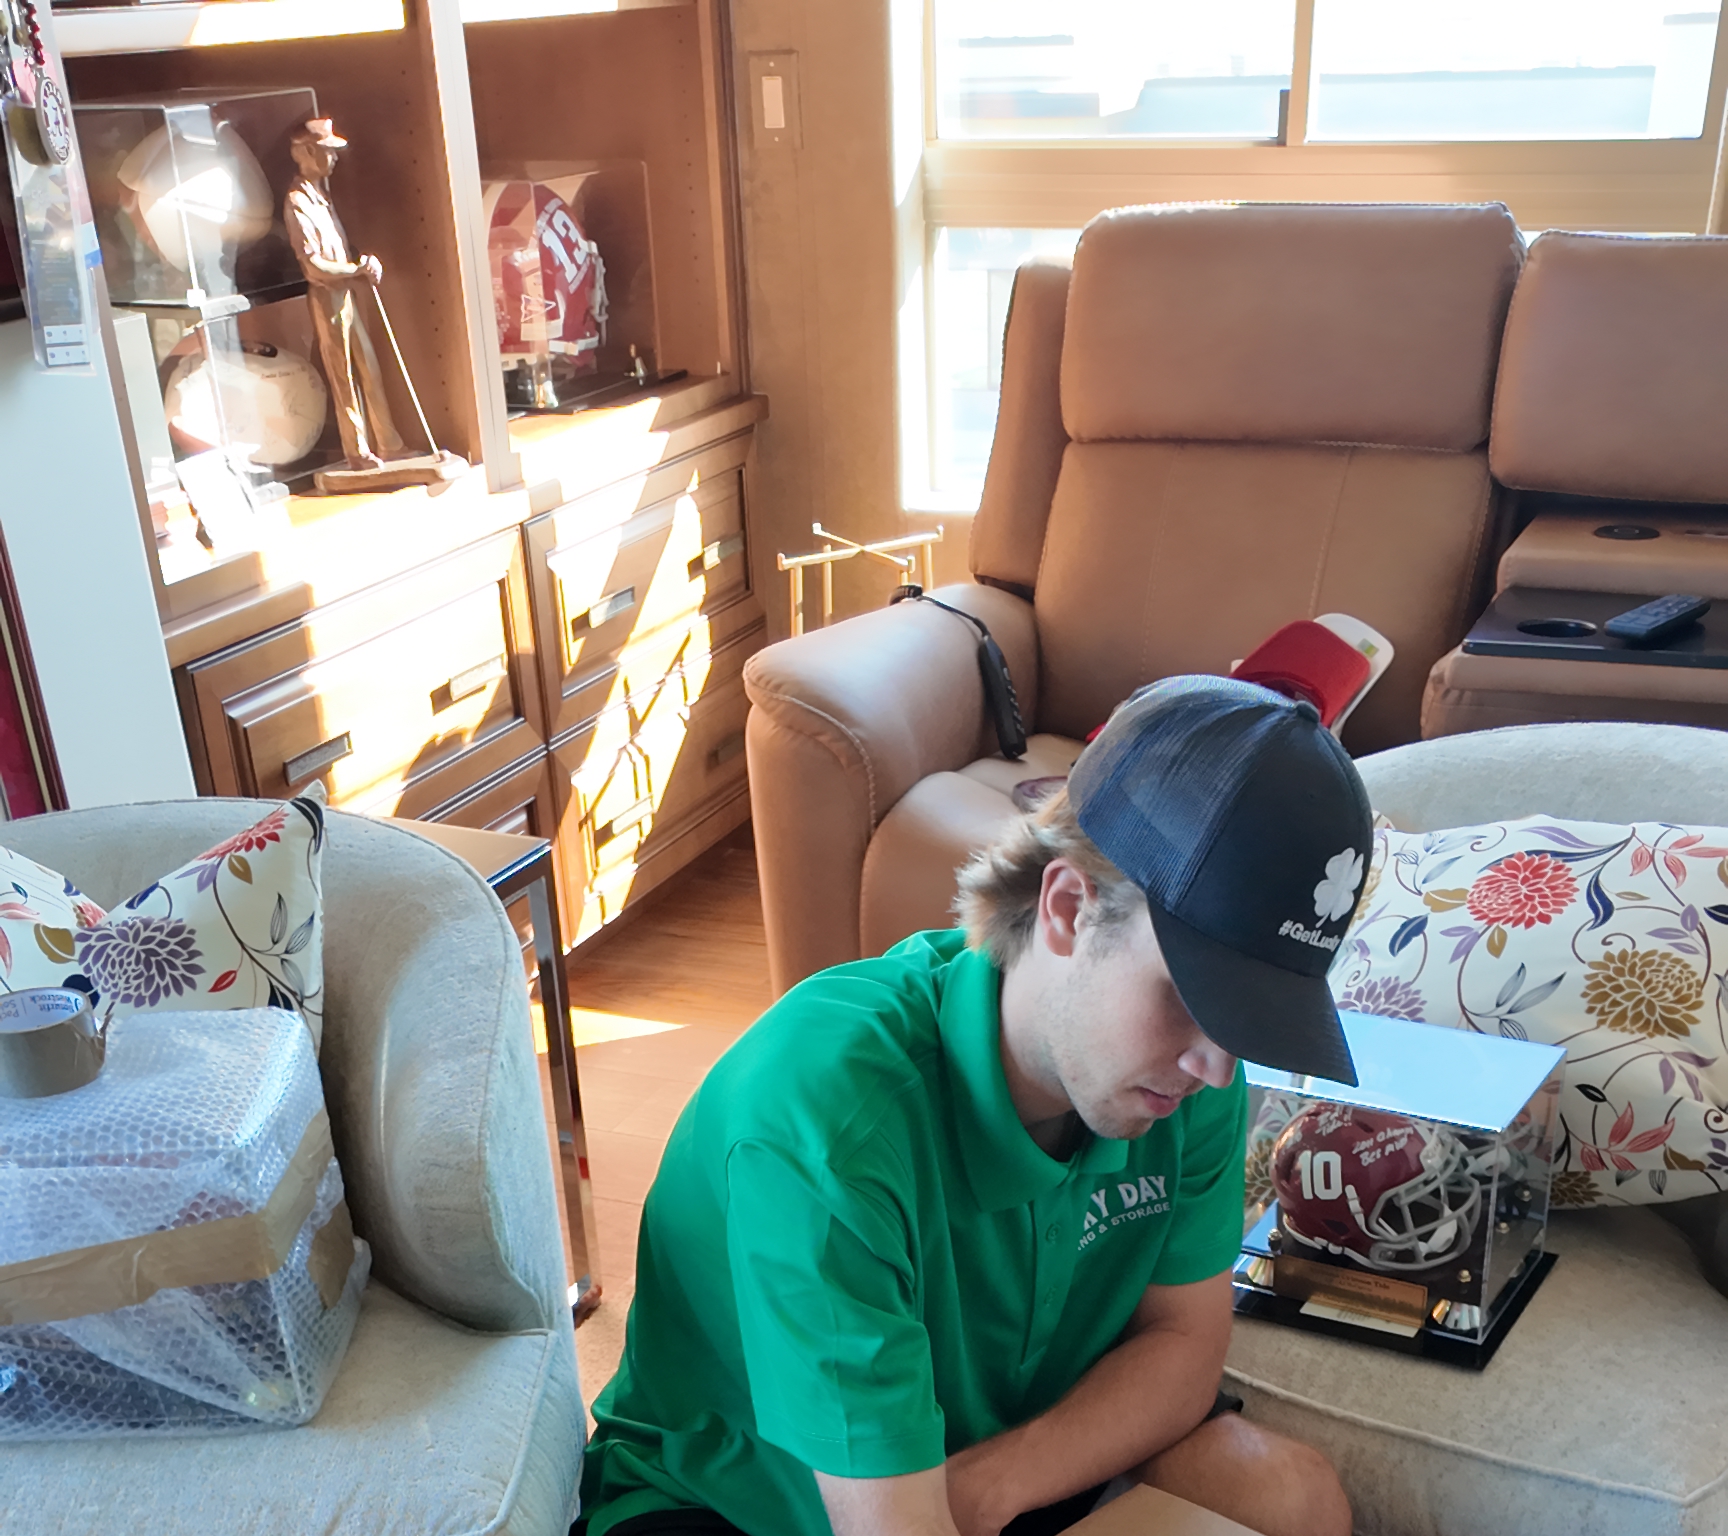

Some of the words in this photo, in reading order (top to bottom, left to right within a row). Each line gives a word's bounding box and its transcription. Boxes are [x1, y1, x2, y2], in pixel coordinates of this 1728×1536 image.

[542, 208, 590, 284] 13
[1117, 1175, 1168, 1210] DAY
[1299, 1149, 1343, 1201] 10
[1098, 1223, 1108, 1234] &
[1110, 1201, 1171, 1226] STORAGE
